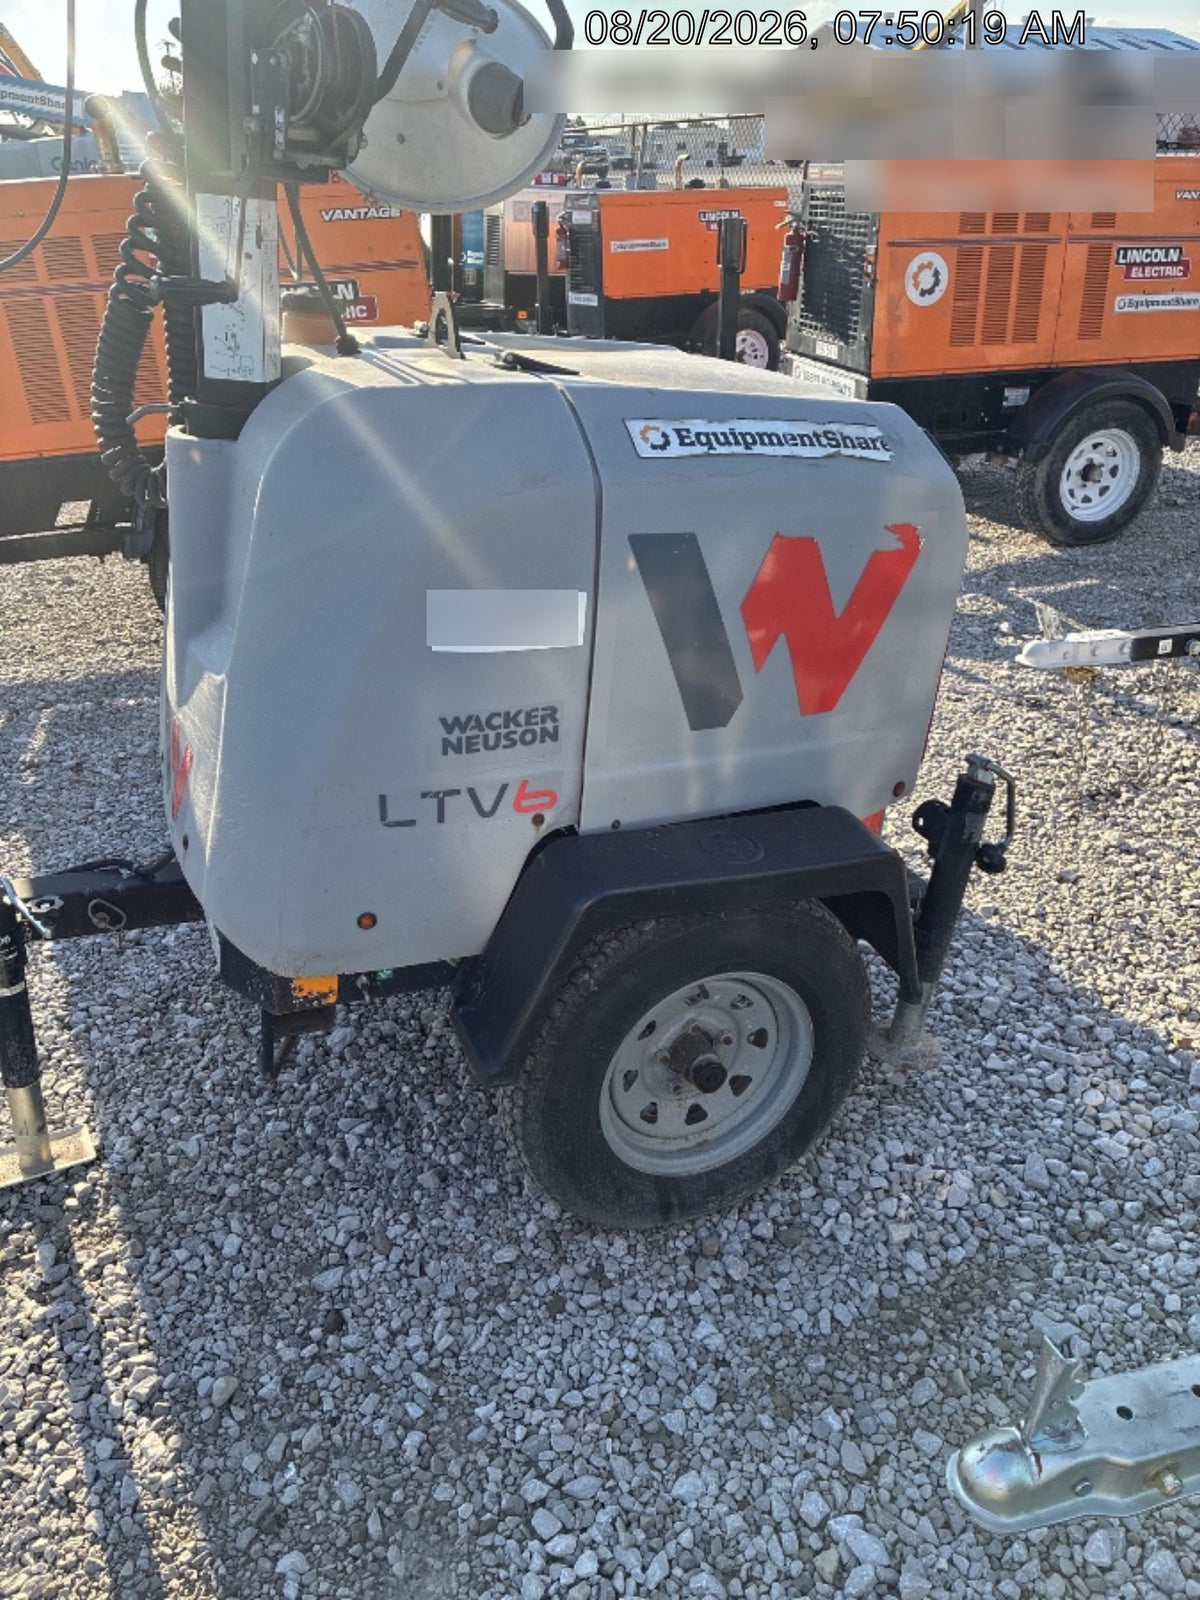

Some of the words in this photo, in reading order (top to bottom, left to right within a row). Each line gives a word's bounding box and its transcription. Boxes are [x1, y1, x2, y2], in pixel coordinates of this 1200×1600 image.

[321, 206, 402, 222] VANTAGE
[1117, 247, 1181, 264] LINCOLN
[1130, 266, 1184, 278] ELECTRIC
[438, 705, 559, 735] WACKER
[441, 725, 559, 756] NEUSON
